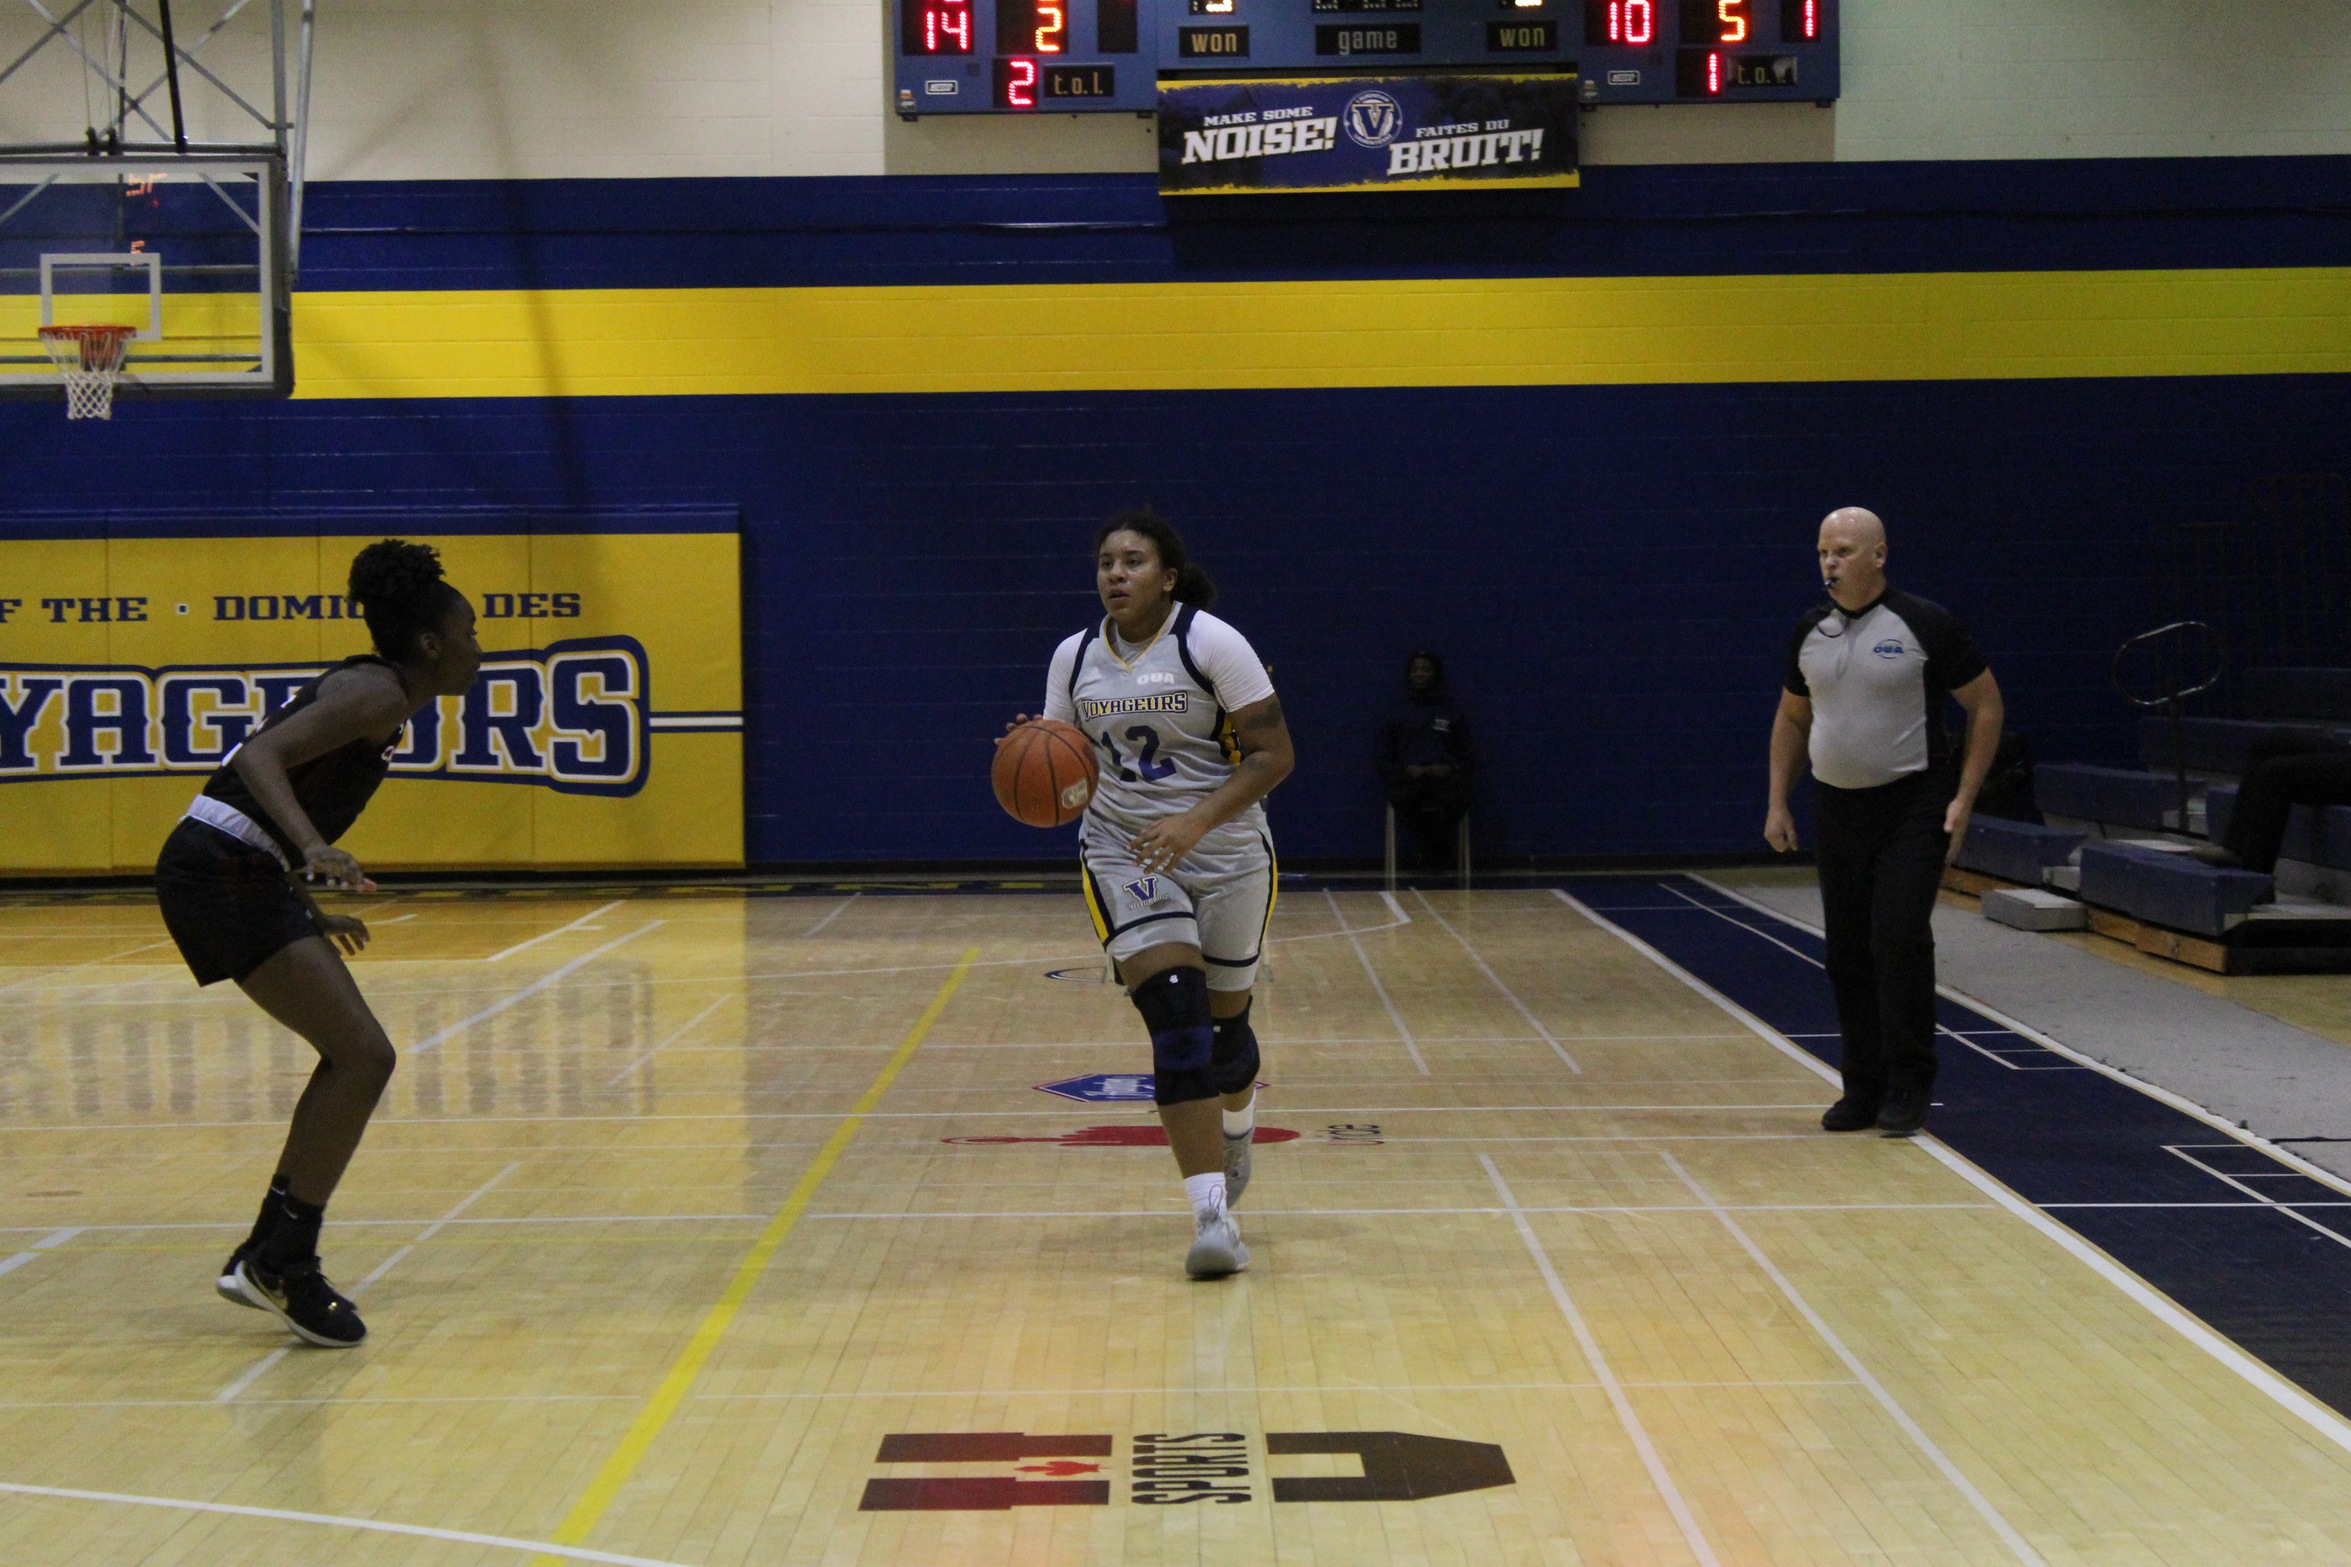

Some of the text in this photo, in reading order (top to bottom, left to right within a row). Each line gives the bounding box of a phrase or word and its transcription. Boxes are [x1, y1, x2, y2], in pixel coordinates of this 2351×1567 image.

[926, 11, 969, 50] 14
[1035, 7, 1062, 51] 2
[1191, 33, 1237, 52] won
[1338, 29, 1397, 55] game
[1500, 28, 1545, 47] won
[1009, 61, 1034, 105] 2
[1709, 53, 1718, 92] 1
[1203, 106, 1314, 127] MAKE SOME
[1415, 118, 1510, 138] FAITES DU
[1181, 116, 1338, 165] NOISE!
[1386, 128, 1544, 176] BRUIT!
[41, 597, 148, 623] THE
[482, 593, 581, 618] DES
[1136, 672, 1175, 685] OUA
[1081, 690, 1188, 721] VOYAGEURS
[1101, 725, 1177, 783] 12
[1122, 875, 1157, 902] V
[1132, 1433, 1251, 1504] SPORTS
